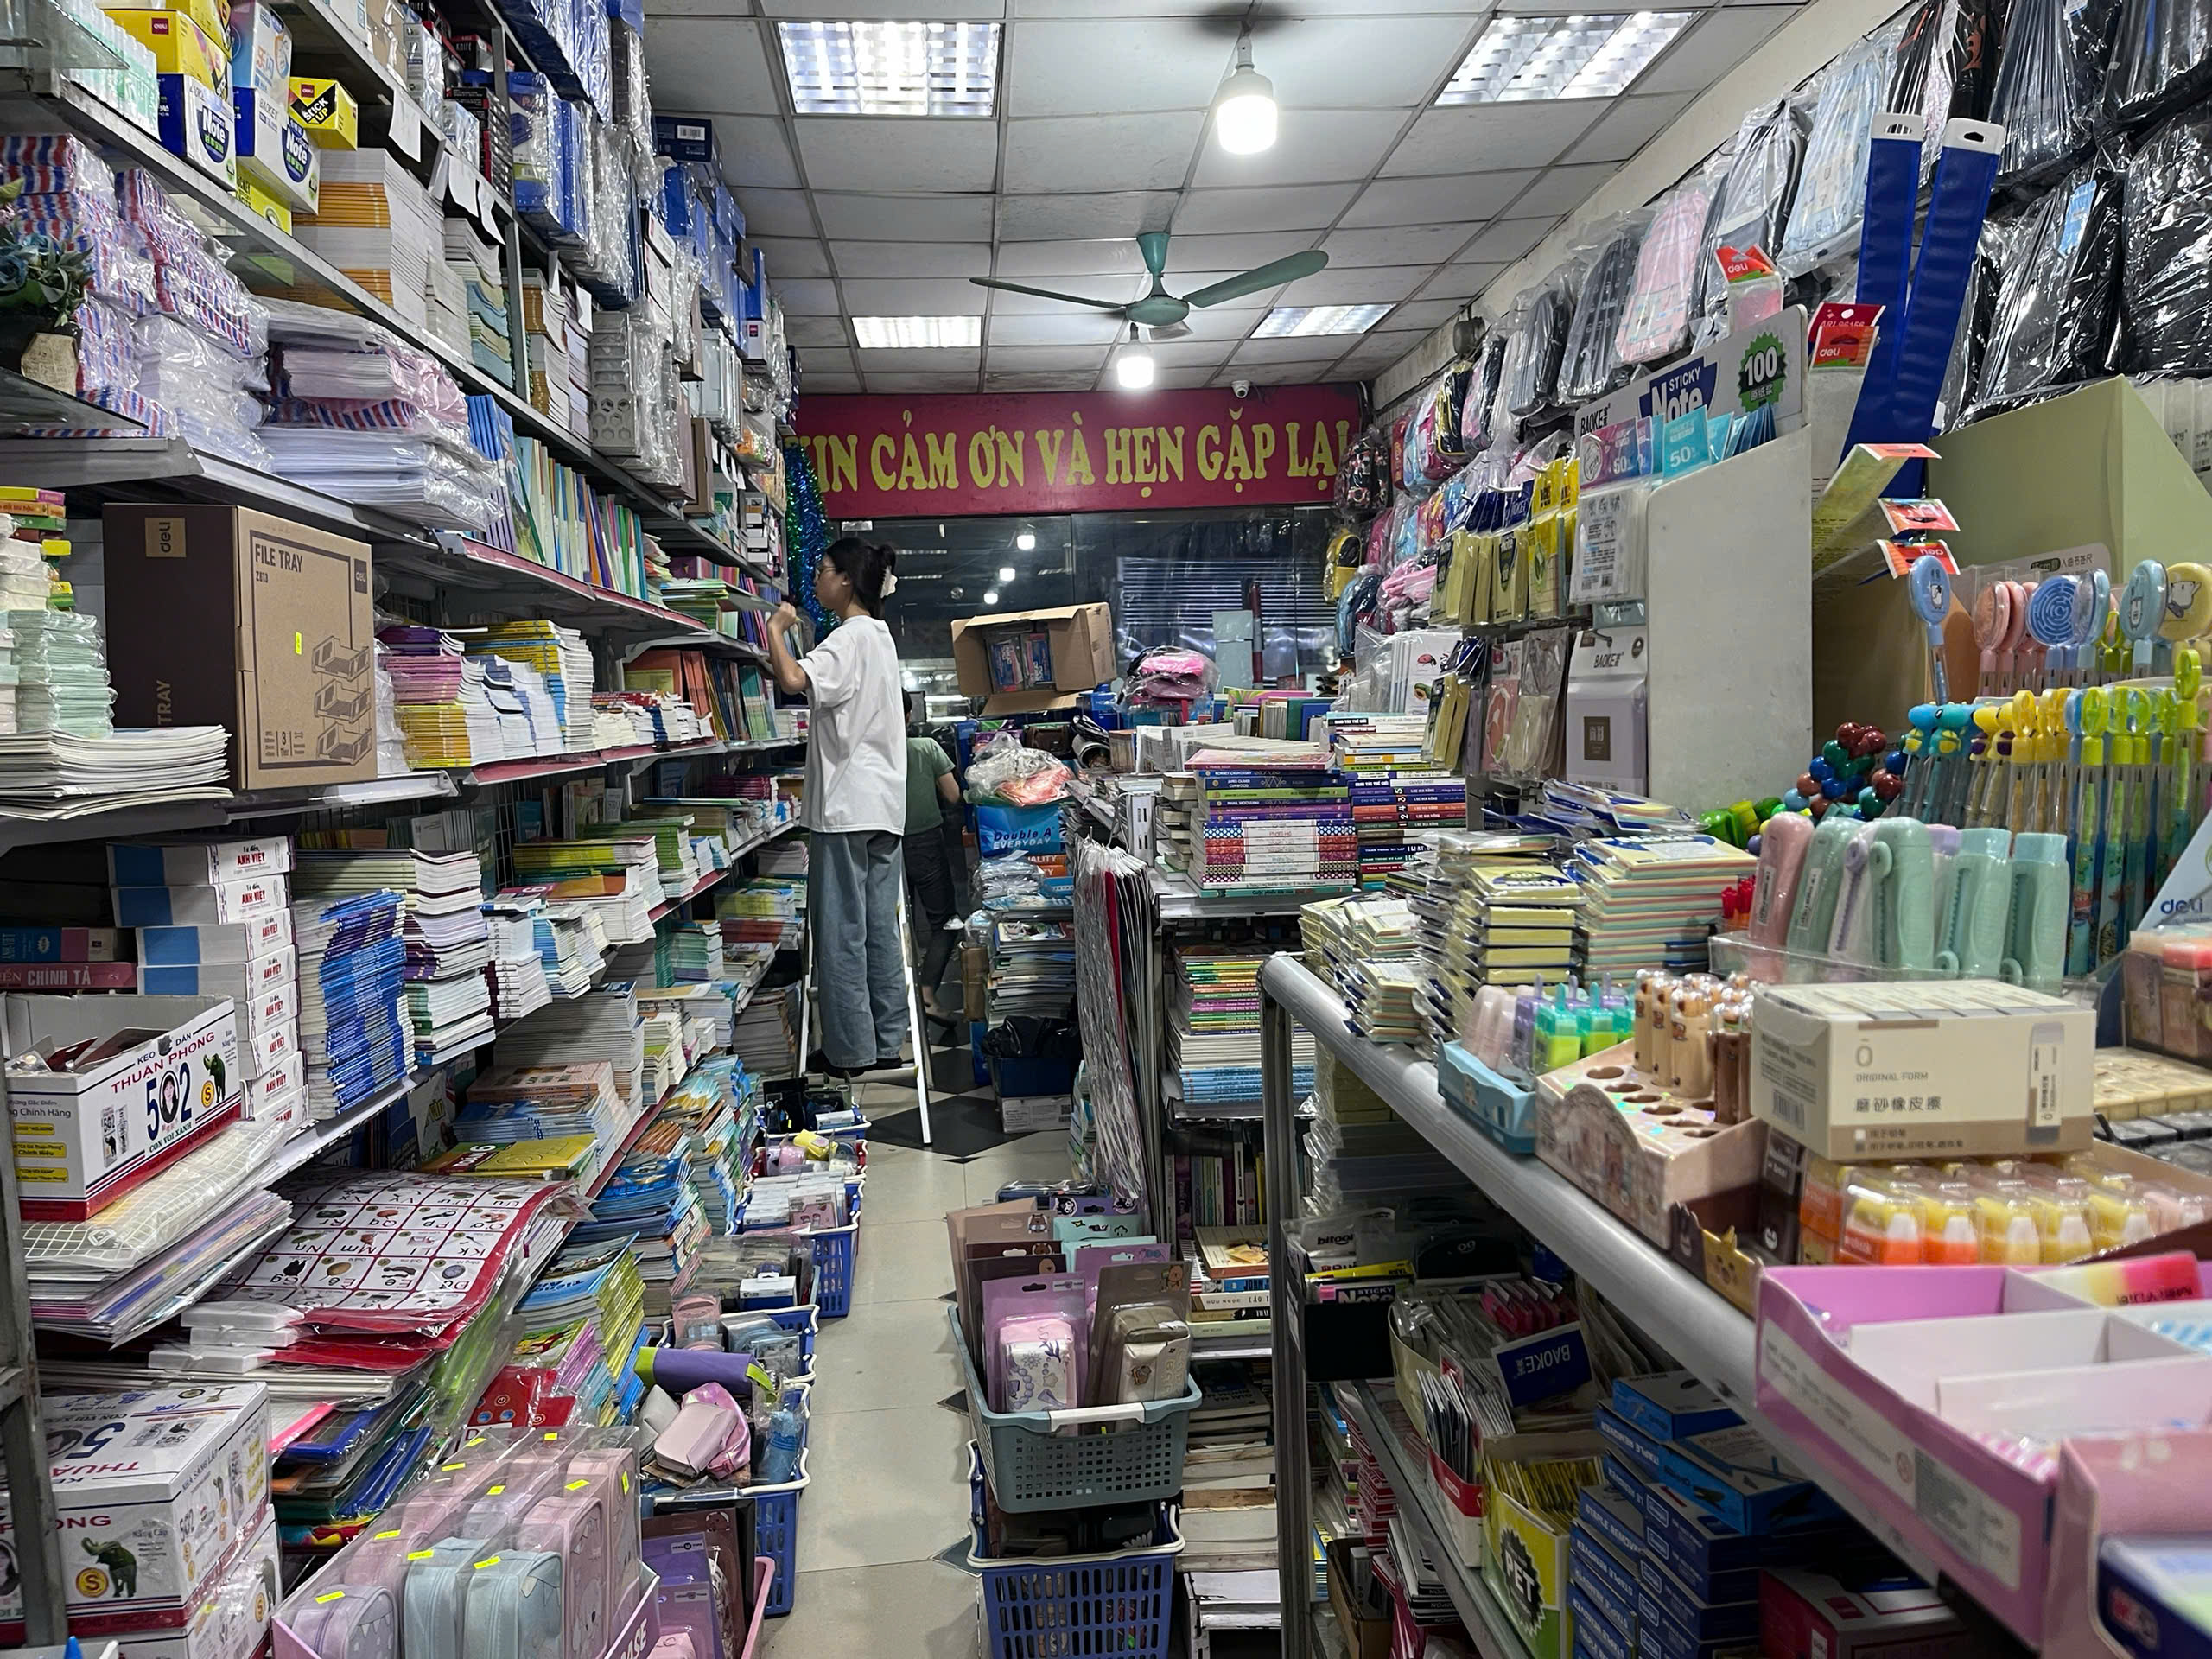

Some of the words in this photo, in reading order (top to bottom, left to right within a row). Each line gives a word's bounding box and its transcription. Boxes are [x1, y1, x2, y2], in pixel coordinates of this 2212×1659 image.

[303, 99, 329, 122] STICK
[316, 108, 328, 123] UP
[202, 106, 226, 143] Note
[285, 125, 308, 165] Note
[1727, 261, 1749, 275] deli
[1820, 346, 1840, 359] deli
[1745, 346, 1777, 386] 100
[1669, 365, 1701, 392] STICKY
[1652, 382, 1704, 423] Note
[784, 435, 858, 493] IN
[870, 409, 959, 492] CẢM
[969, 424, 1025, 489] ƠN
[1034, 411, 1096, 486] VÀ
[1103, 425, 1185, 498] HẸN
[1196, 406, 1275, 493] GẶP
[1669, 446, 1691, 468] 50
[159, 521, 171, 553] deli
[255, 543, 276, 569] FILE
[278, 550, 303, 573] TRAY
[355, 571, 366, 582] deli
[156, 680, 171, 725] TRAY
[994, 836, 1051, 849] EVERYDAY
[995, 829, 1039, 842] Double
[1044, 827, 1052, 836] A
[2161, 899, 2202, 914] deli
[0, 968, 22, 982] IỂN
[27, 969, 68, 987] CHÍNH
[73, 965, 92, 985] TẢ
[137, 1051, 156, 1065] KEO
[175, 1033, 192, 1046] DÁN
[168, 1031, 215, 1065] PHONG
[1856, 1072, 1898, 1082] ORIGINAL
[1902, 1071, 1929, 1081] FORM
[20, 1108, 46, 1116] Chính
[146, 1061, 192, 1141] 502
[1855, 1096, 1942, 1113] 磨砂橡皮擦
[175, 1122, 193, 1140] XANH
[1357, 1287, 1393, 1295] STICKY
[1526, 1344, 1571, 1374] BAOKE
[1505, 1557, 1535, 1601] PET
